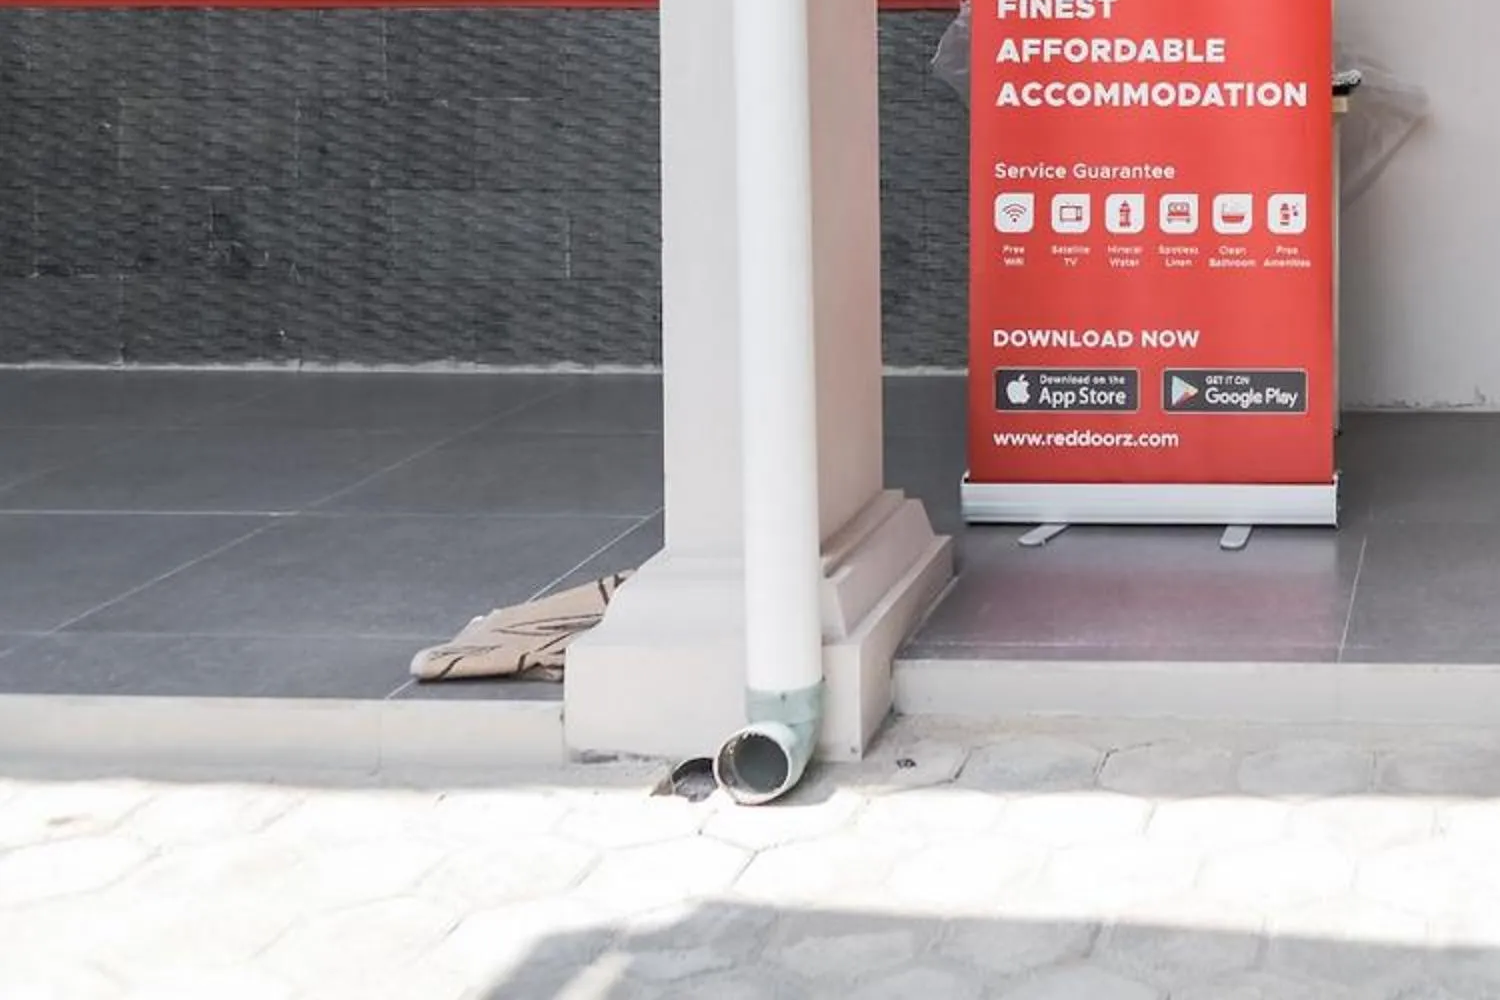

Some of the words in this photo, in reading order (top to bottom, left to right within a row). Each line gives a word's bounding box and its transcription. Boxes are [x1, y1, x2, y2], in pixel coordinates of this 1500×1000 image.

[997, 38, 1225, 62] AFFORDABLE
[997, 82, 1306, 106] ACCOMMODATION
[995, 163, 1066, 178] Service
[1073, 163, 1174, 178] Guarantee
[1063, 258, 1079, 266] TV
[994, 330, 1133, 347] DOWNLOAD
[1142, 330, 1199, 347] NOW
[1039, 375, 1091, 384] Download
[1092, 376, 1107, 384] on
[1108, 376, 1126, 384] the
[1205, 376, 1223, 384] GET
[1234, 376, 1250, 385] ON
[1039, 387, 1076, 408] App
[1079, 387, 1126, 404] Store
[1205, 387, 1262, 408] Google
[1266, 388, 1298, 408] Play
[994, 430, 1178, 447] www.reddoorz.com
